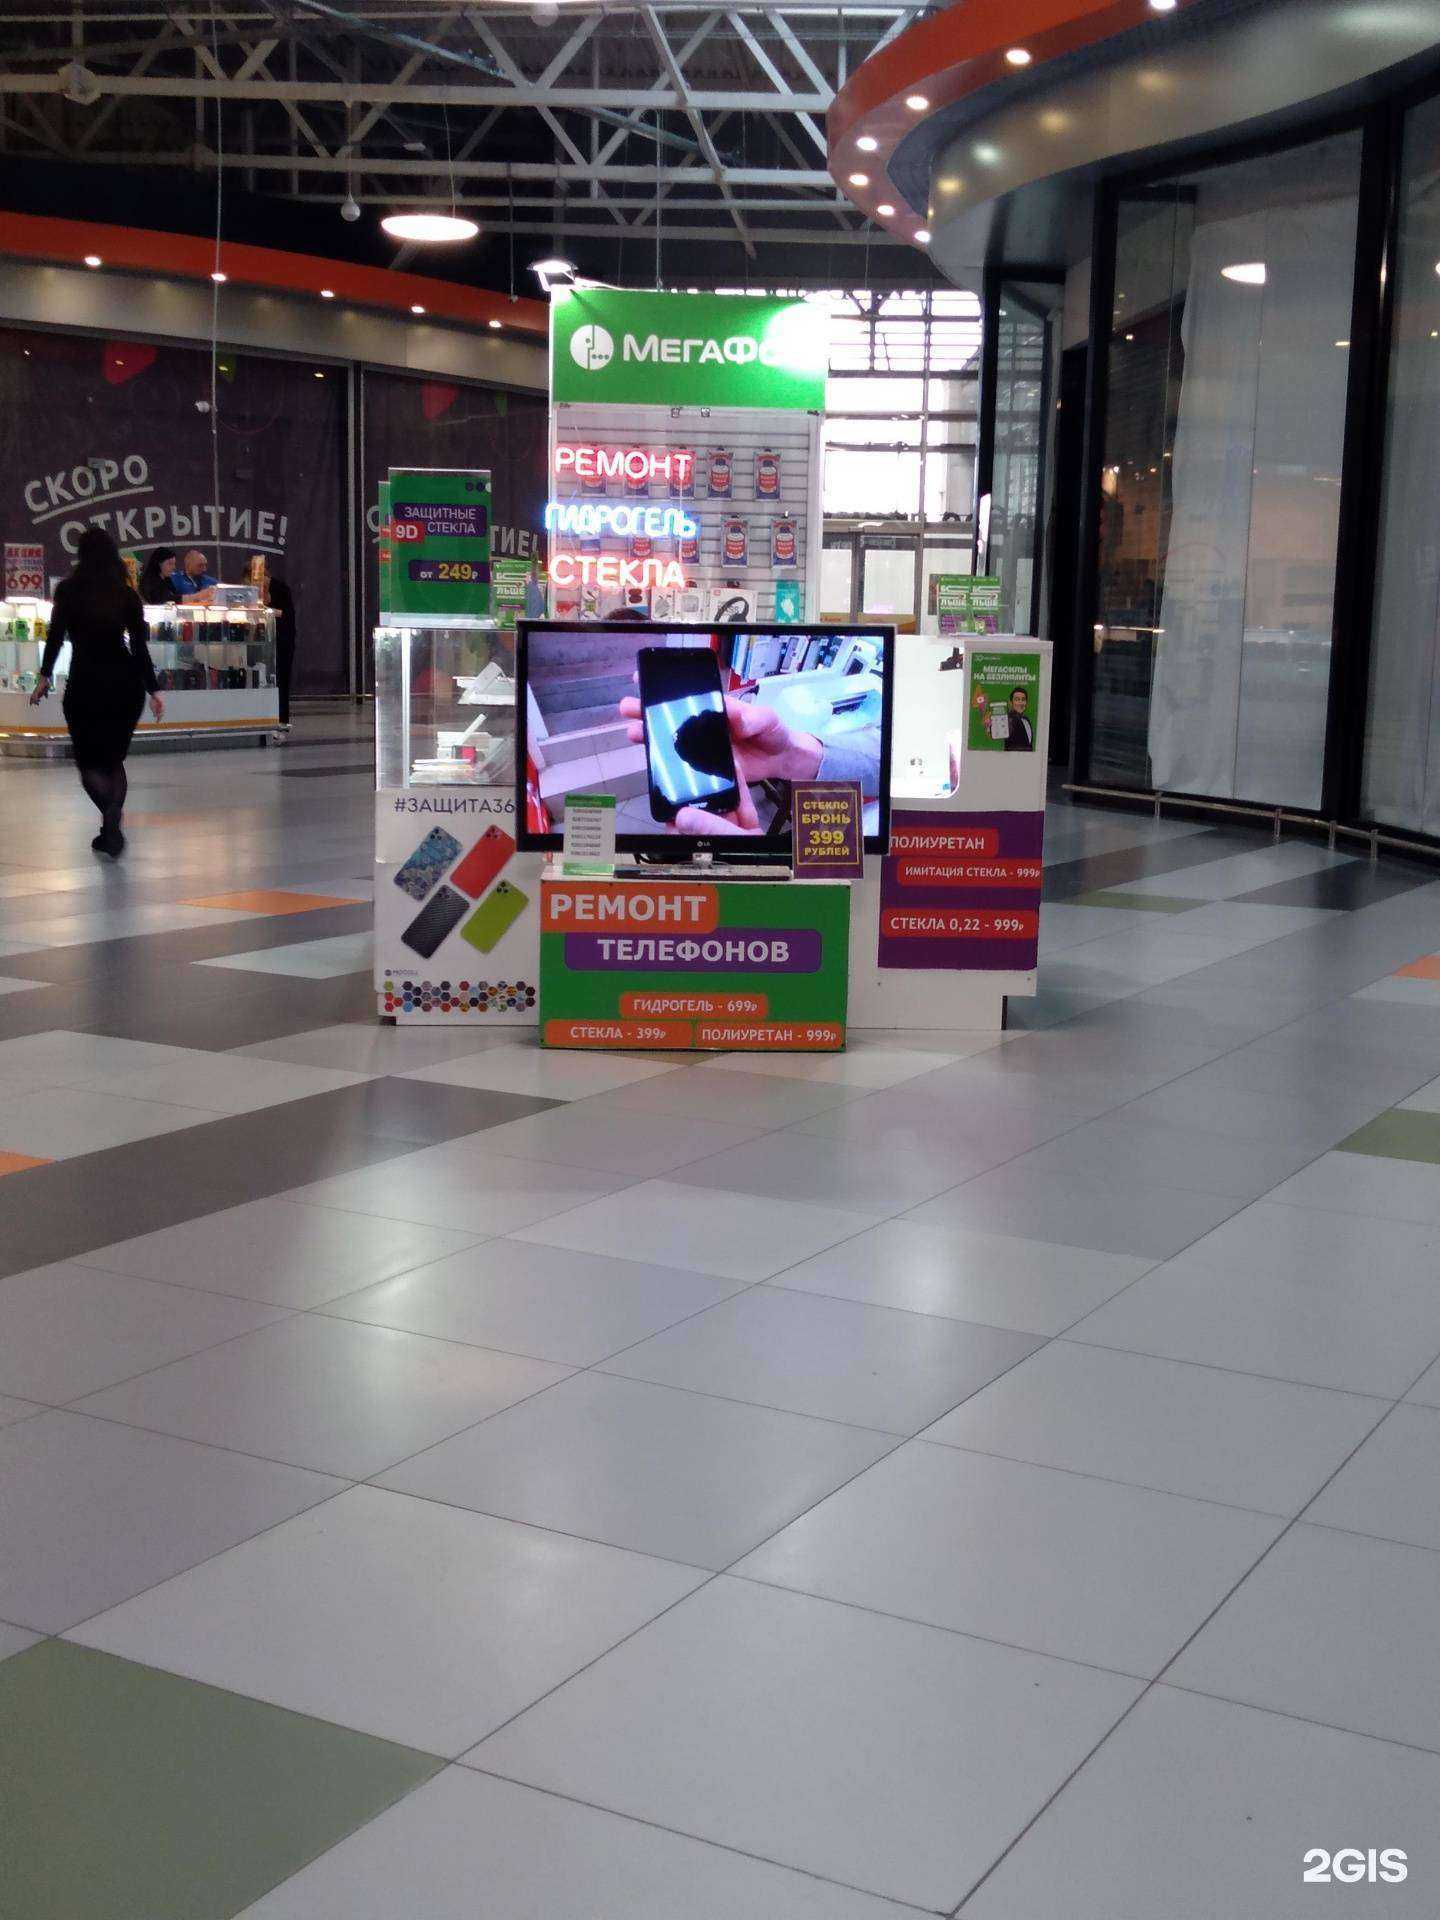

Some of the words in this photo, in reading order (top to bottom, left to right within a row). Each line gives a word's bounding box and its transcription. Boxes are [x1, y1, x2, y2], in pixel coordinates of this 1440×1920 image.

[554, 447, 693, 480] РЕМОНТ
[25, 454, 149, 513] СКОРО
[404, 506, 477, 520] ЗАЩИТНЫЕ
[395, 524, 418, 539] 9D
[427, 521, 477, 534] СТЕКЛА
[548, 554, 686, 589] СТЕКЛА
[803, 801, 849, 810] СТЕКЛО
[801, 813, 851, 824] БРОНЬ
[809, 830, 845, 844] 399
[889, 836, 985, 850] ПОЛИУРЕТАН
[804, 846, 850, 856] РУБЛЕЙ
[905, 866, 964, 878] ИМИТАЦИЯ
[966, 867, 1007, 878] СТЕКЛА
[550, 893, 707, 922] РЕМОНТ
[890, 917, 946, 930] СТЕКЛА
[950, 918, 980, 933] 0,22
[596, 938, 790, 962] ТЕЛЕФОНОВ
[633, 999, 714, 1013] ГИДРОГЕЛЬ
[570, 1026, 623, 1039] СТЕКЛА
[702, 1028, 793, 1041] ПОЛИУРЕТАН
